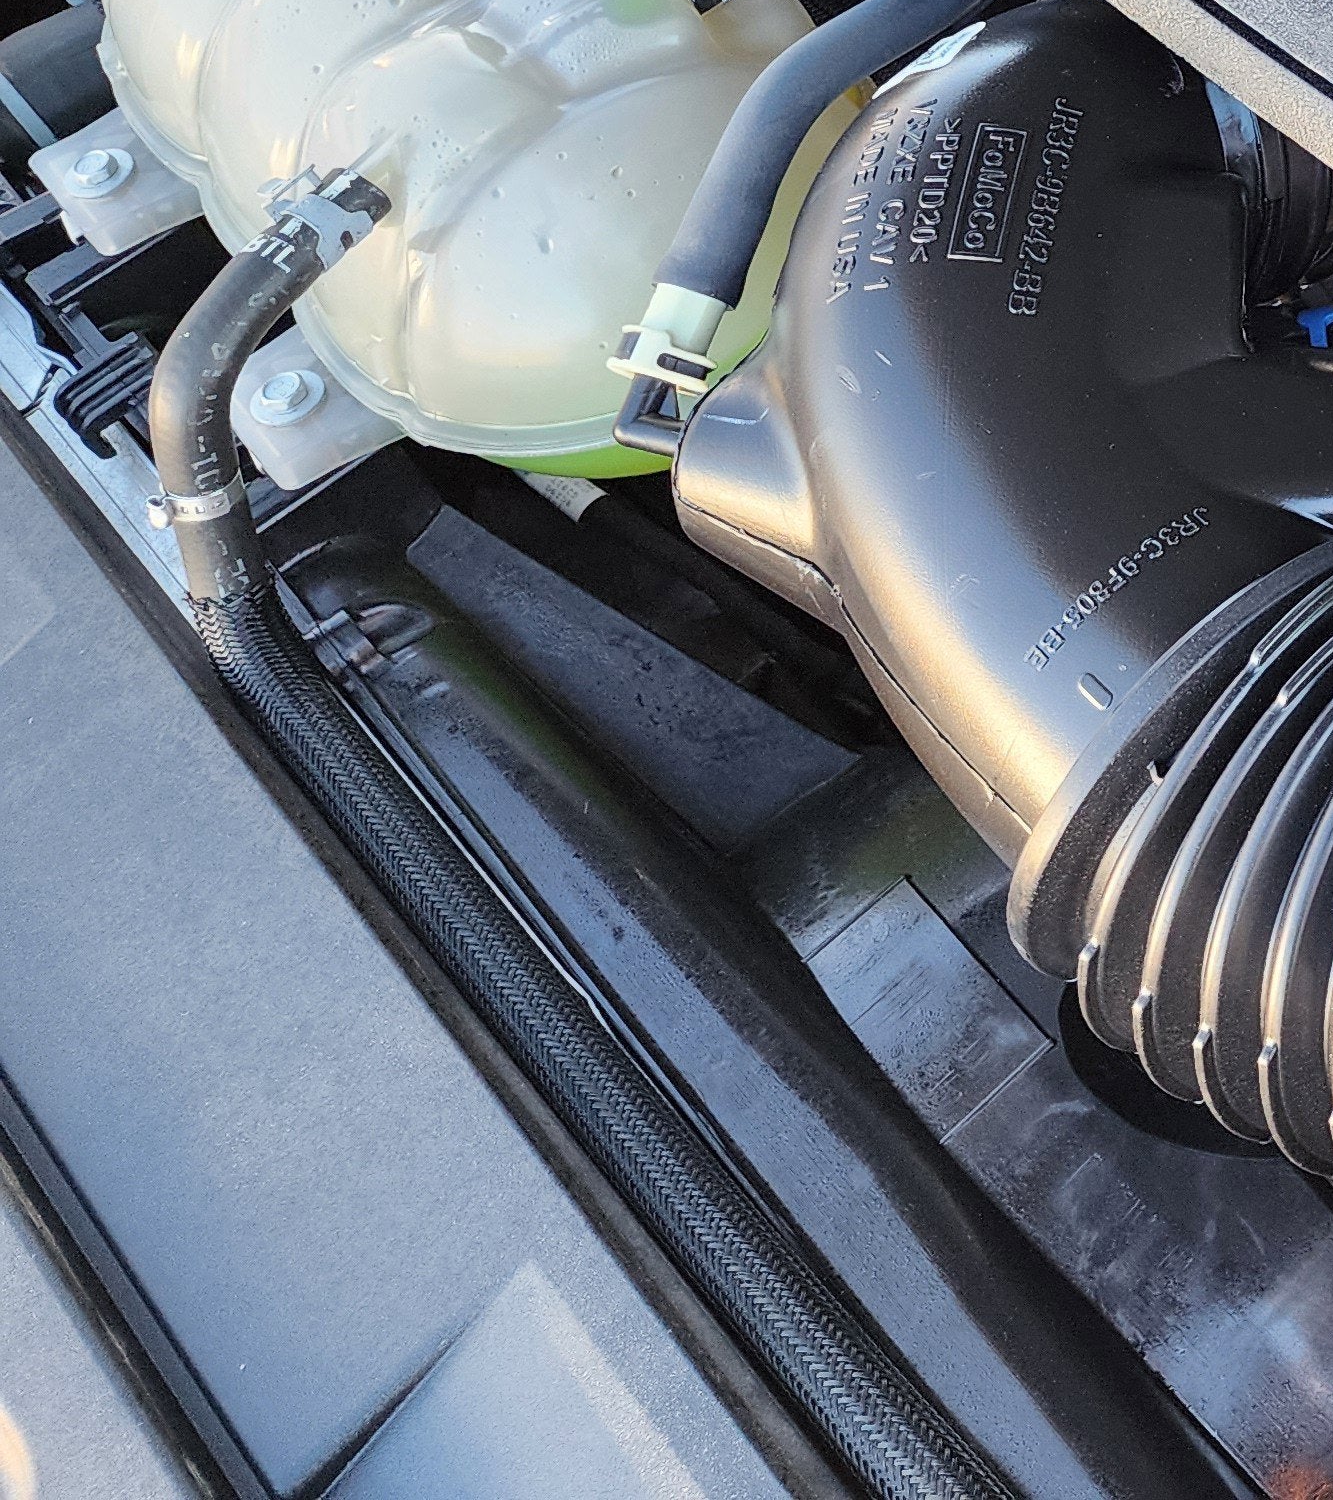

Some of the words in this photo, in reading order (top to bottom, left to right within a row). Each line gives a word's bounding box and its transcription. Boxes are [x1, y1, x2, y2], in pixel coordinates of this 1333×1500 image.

[853, 106, 900, 187] MADE
[841, 191, 872, 225] IN
[963, 132, 1016, 251] FoMoCo
[1007, 96, 1085, 318] JR3C-9B642-BB
[826, 230, 863, 306] USA
[869, 198, 906, 266] CAV
